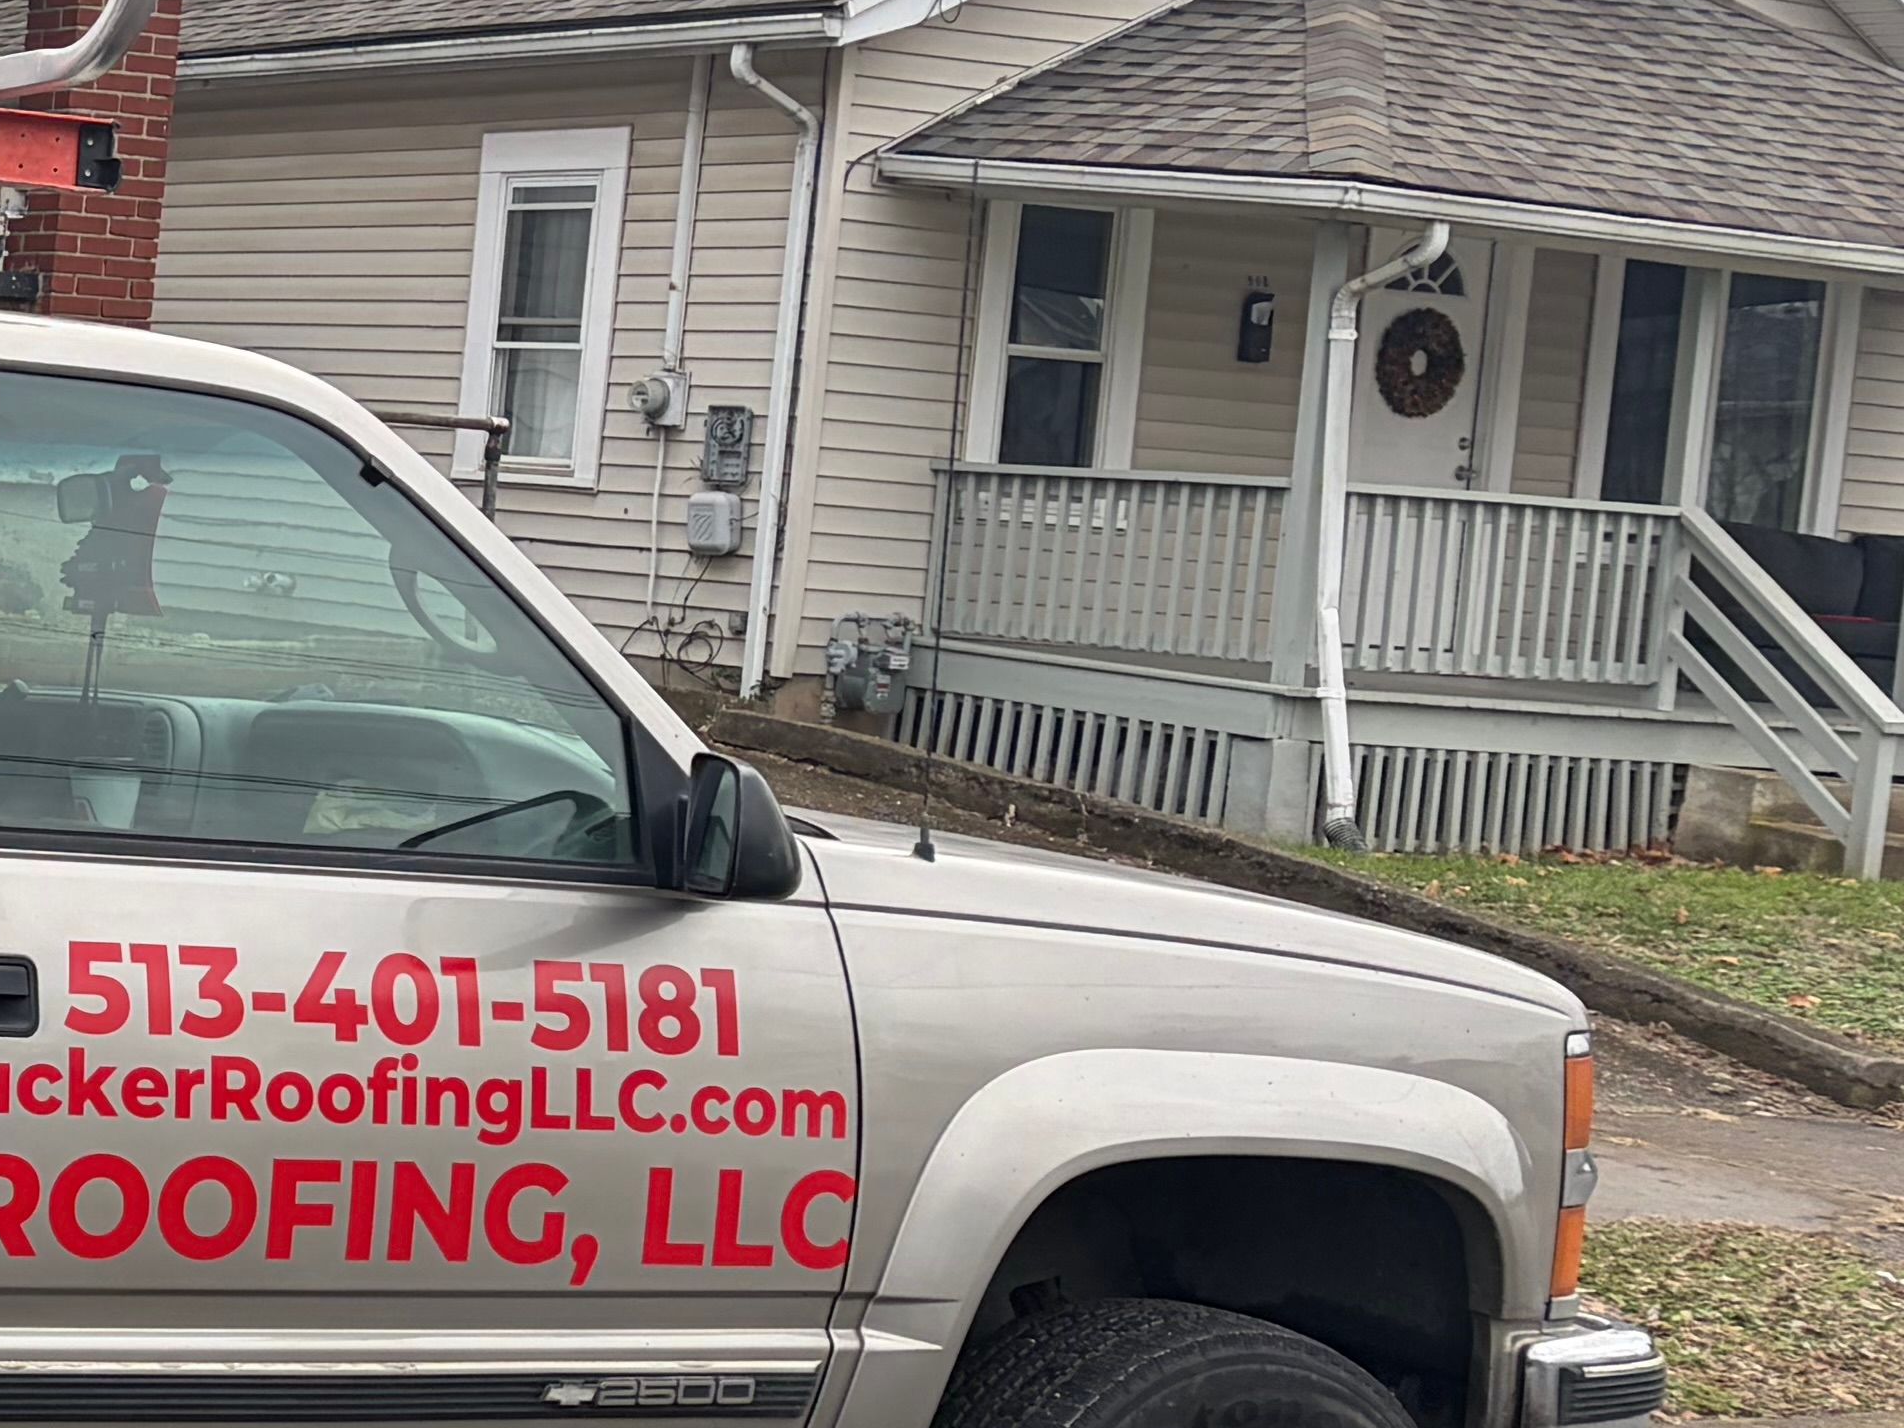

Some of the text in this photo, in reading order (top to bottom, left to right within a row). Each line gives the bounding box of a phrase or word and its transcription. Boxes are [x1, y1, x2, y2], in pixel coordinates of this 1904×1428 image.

[65, 941, 740, 1057] 513-401-5181
[642, 1167, 858, 1271] LLC
[597, 1376, 757, 1407] 2500
